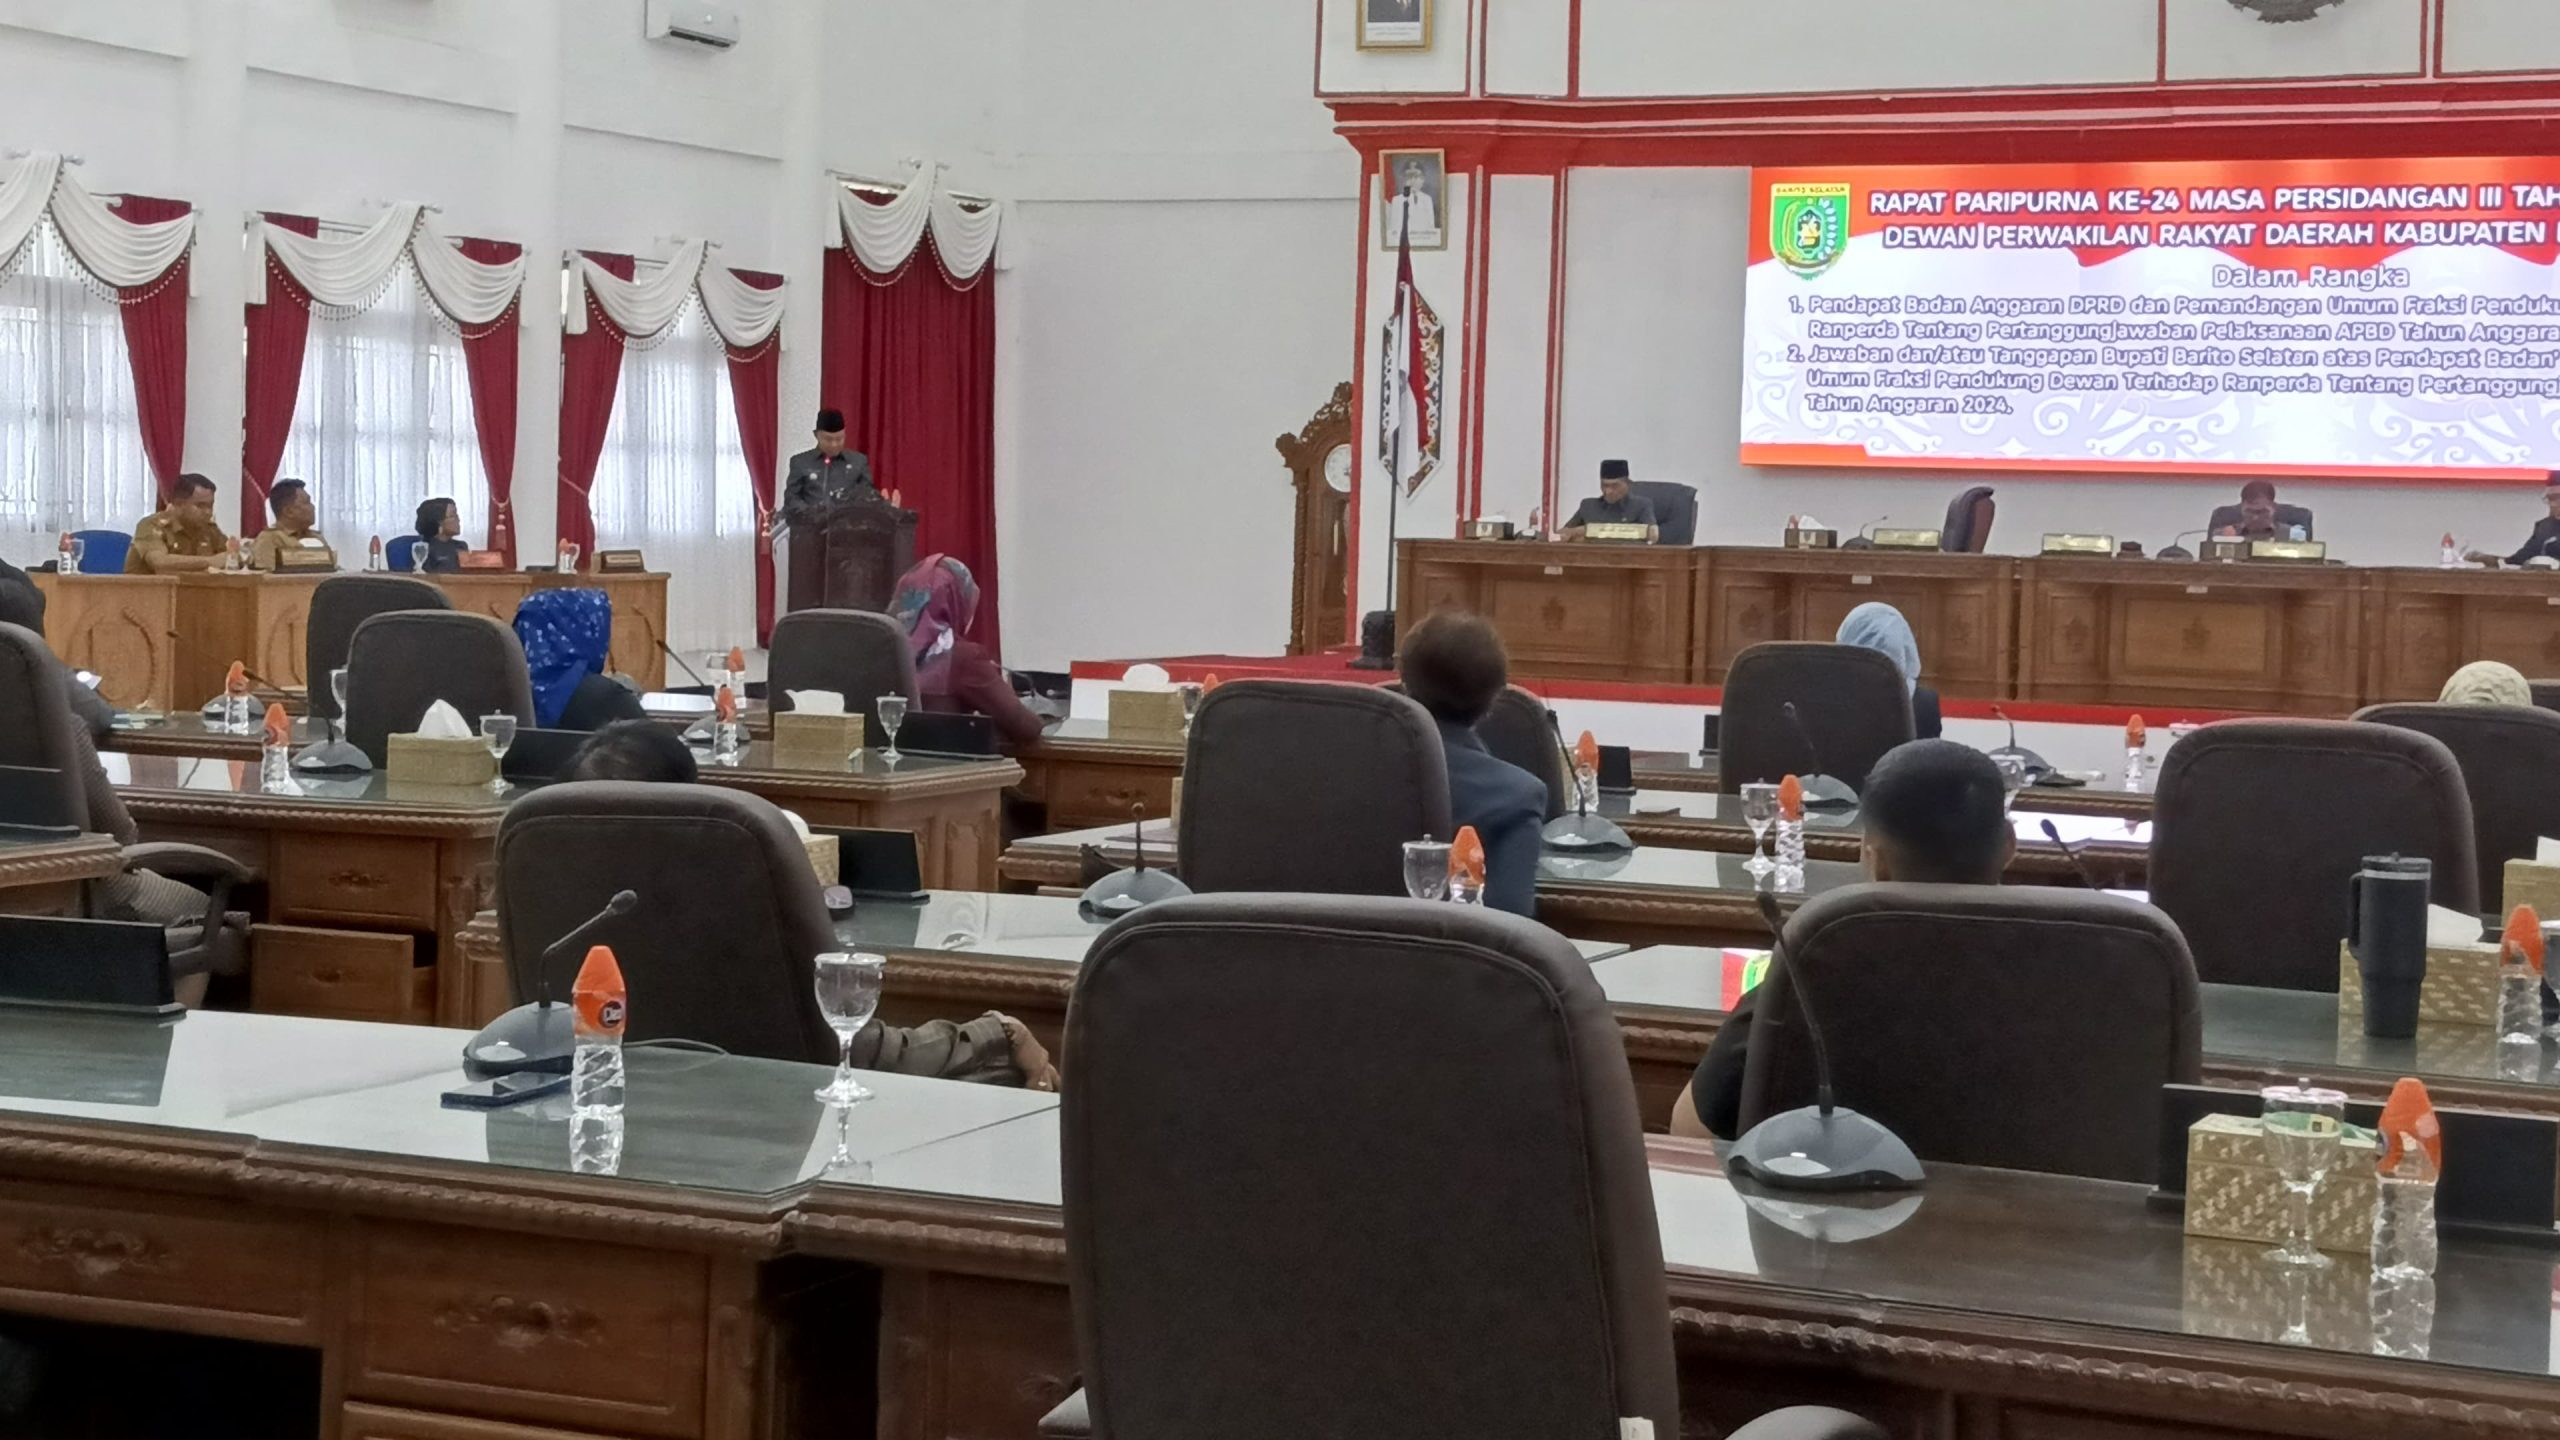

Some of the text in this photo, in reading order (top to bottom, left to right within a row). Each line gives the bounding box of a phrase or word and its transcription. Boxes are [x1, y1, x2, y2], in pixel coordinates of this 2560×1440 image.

[1870, 191, 1947, 214] RAPAT
[1955, 190, 2099, 213] PARIPURNA
[2108, 189, 2179, 213] KE-24
[2189, 189, 2265, 212] MASA
[2274, 186, 2468, 211] PERSIDANGAN
[2479, 186, 2502, 209] III
[1885, 225, 1977, 248] DEWAN
[1986, 224, 2149, 248] PERWAKILAN
[2159, 222, 2256, 246] RAKYAT
[2265, 222, 2374, 246] DAERAH
[2384, 221, 2546, 245] KABUPATEN
[2212, 264, 2410, 292] Dalam Rangka
[1789, 296, 1804, 314] 1.
[1809, 296, 1900, 317] Pendapat
[1904, 296, 1965, 314] Badan
[1970, 296, 2063, 318] Anggaran
[2068, 297, 2124, 315] DPRD
[2129, 297, 2170, 315] dan
[2174, 297, 2321, 319] Pemandangan
[2326, 297, 2398, 315] Umum
[2403, 296, 2467, 315] Fraksi
[1808, 320, 1899, 341] Ranperda
[1903, 321, 1982, 341] Tentang
[1986, 321, 2196, 343] Pertanggungjawaban
[2201, 322, 2331, 341] Pelaksanaan
[2335, 322, 2395, 341] APBD
[2399, 322, 2465, 341] Tahun
[1787, 345, 1805, 363] 2.
[1808, 346, 1893, 364] Jawaban
[1898, 346, 1985, 365] dan/atau
[1988, 346, 2096, 368] Tanggapan
[2102, 347, 2168, 369] Bupati
[2172, 348, 2234, 366] Barito
[2238, 348, 2318, 367] Selatan
[2323, 349, 2370, 367] atas
[2375, 347, 2481, 370] Pendapat
[1806, 370, 1869, 388] Umum
[1874, 370, 1930, 388] Fraksi
[1935, 370, 2044, 393] Pendukung
[2048, 372, 2119, 390] Dewan
[2123, 373, 2218, 394] Terhadap
[2222, 373, 2322, 395] Ranperda
[2326, 374, 2414, 396] Tentang
[1805, 394, 1863, 412] Tahun
[1866, 395, 1959, 416] Anggaran
